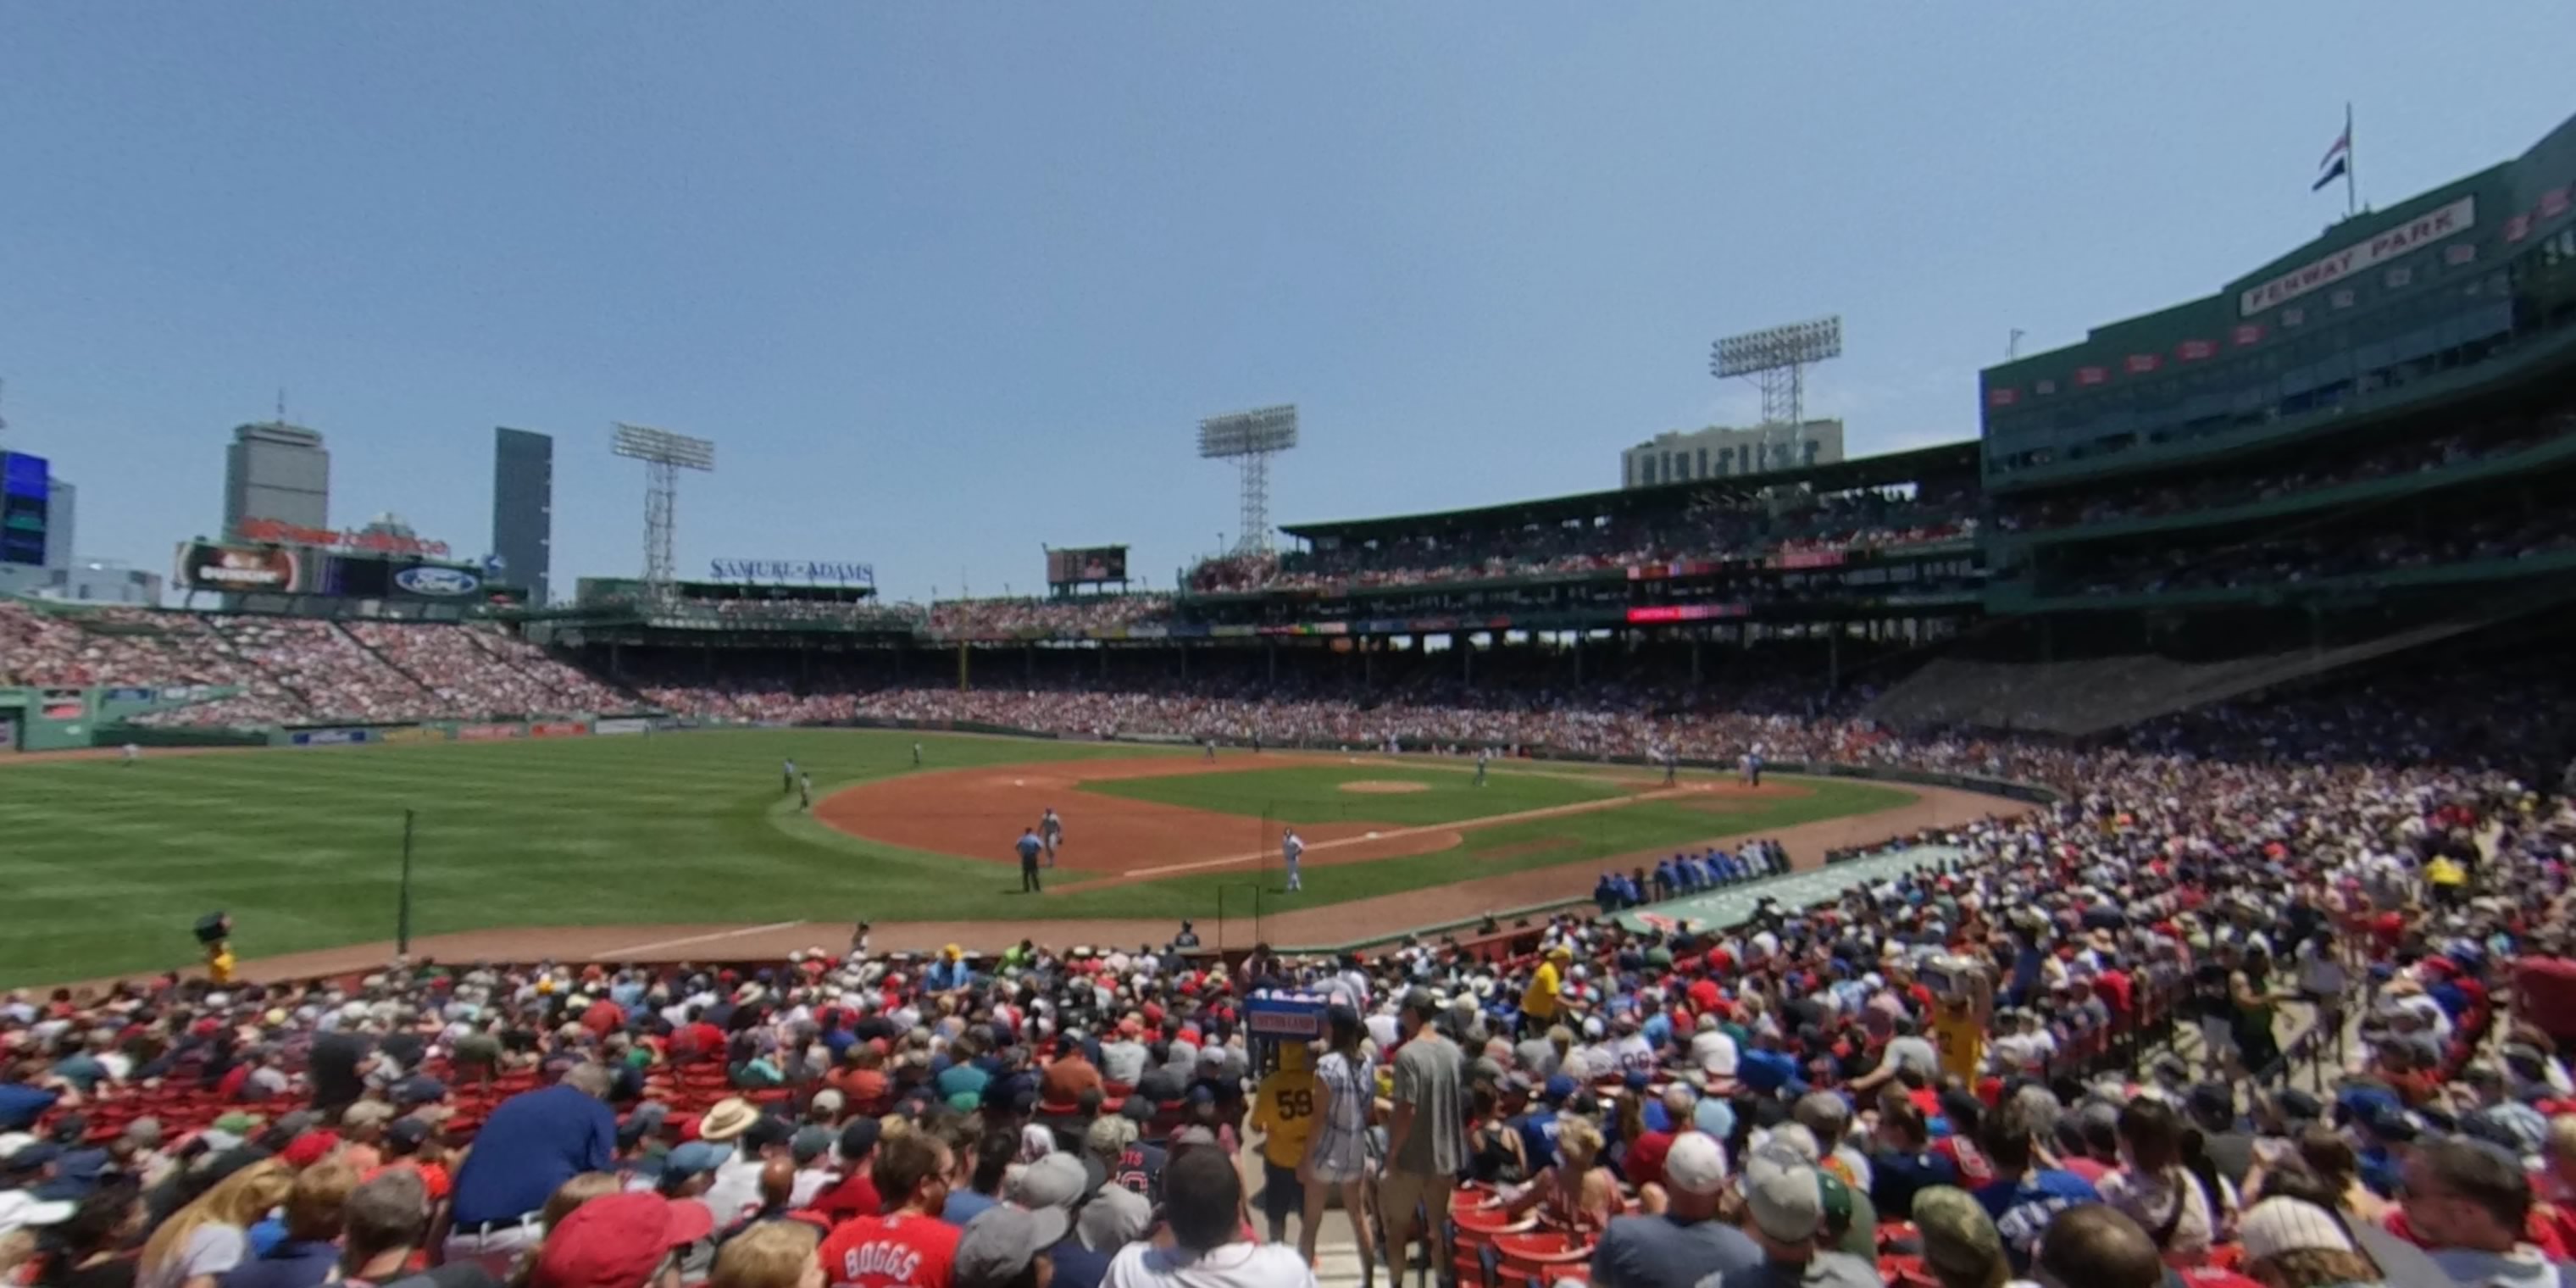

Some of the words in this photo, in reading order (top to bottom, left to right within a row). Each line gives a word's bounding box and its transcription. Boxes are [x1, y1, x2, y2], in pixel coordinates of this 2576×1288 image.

[2250, 252, 2353, 307] FENWAY
[2370, 212, 2456, 257] PARK
[711, 558, 792, 578] SAMUEL
[805, 560, 873, 581] ADAMS
[1276, 1089, 1313, 1120] 59
[845, 1240, 922, 1281] BOGGS
